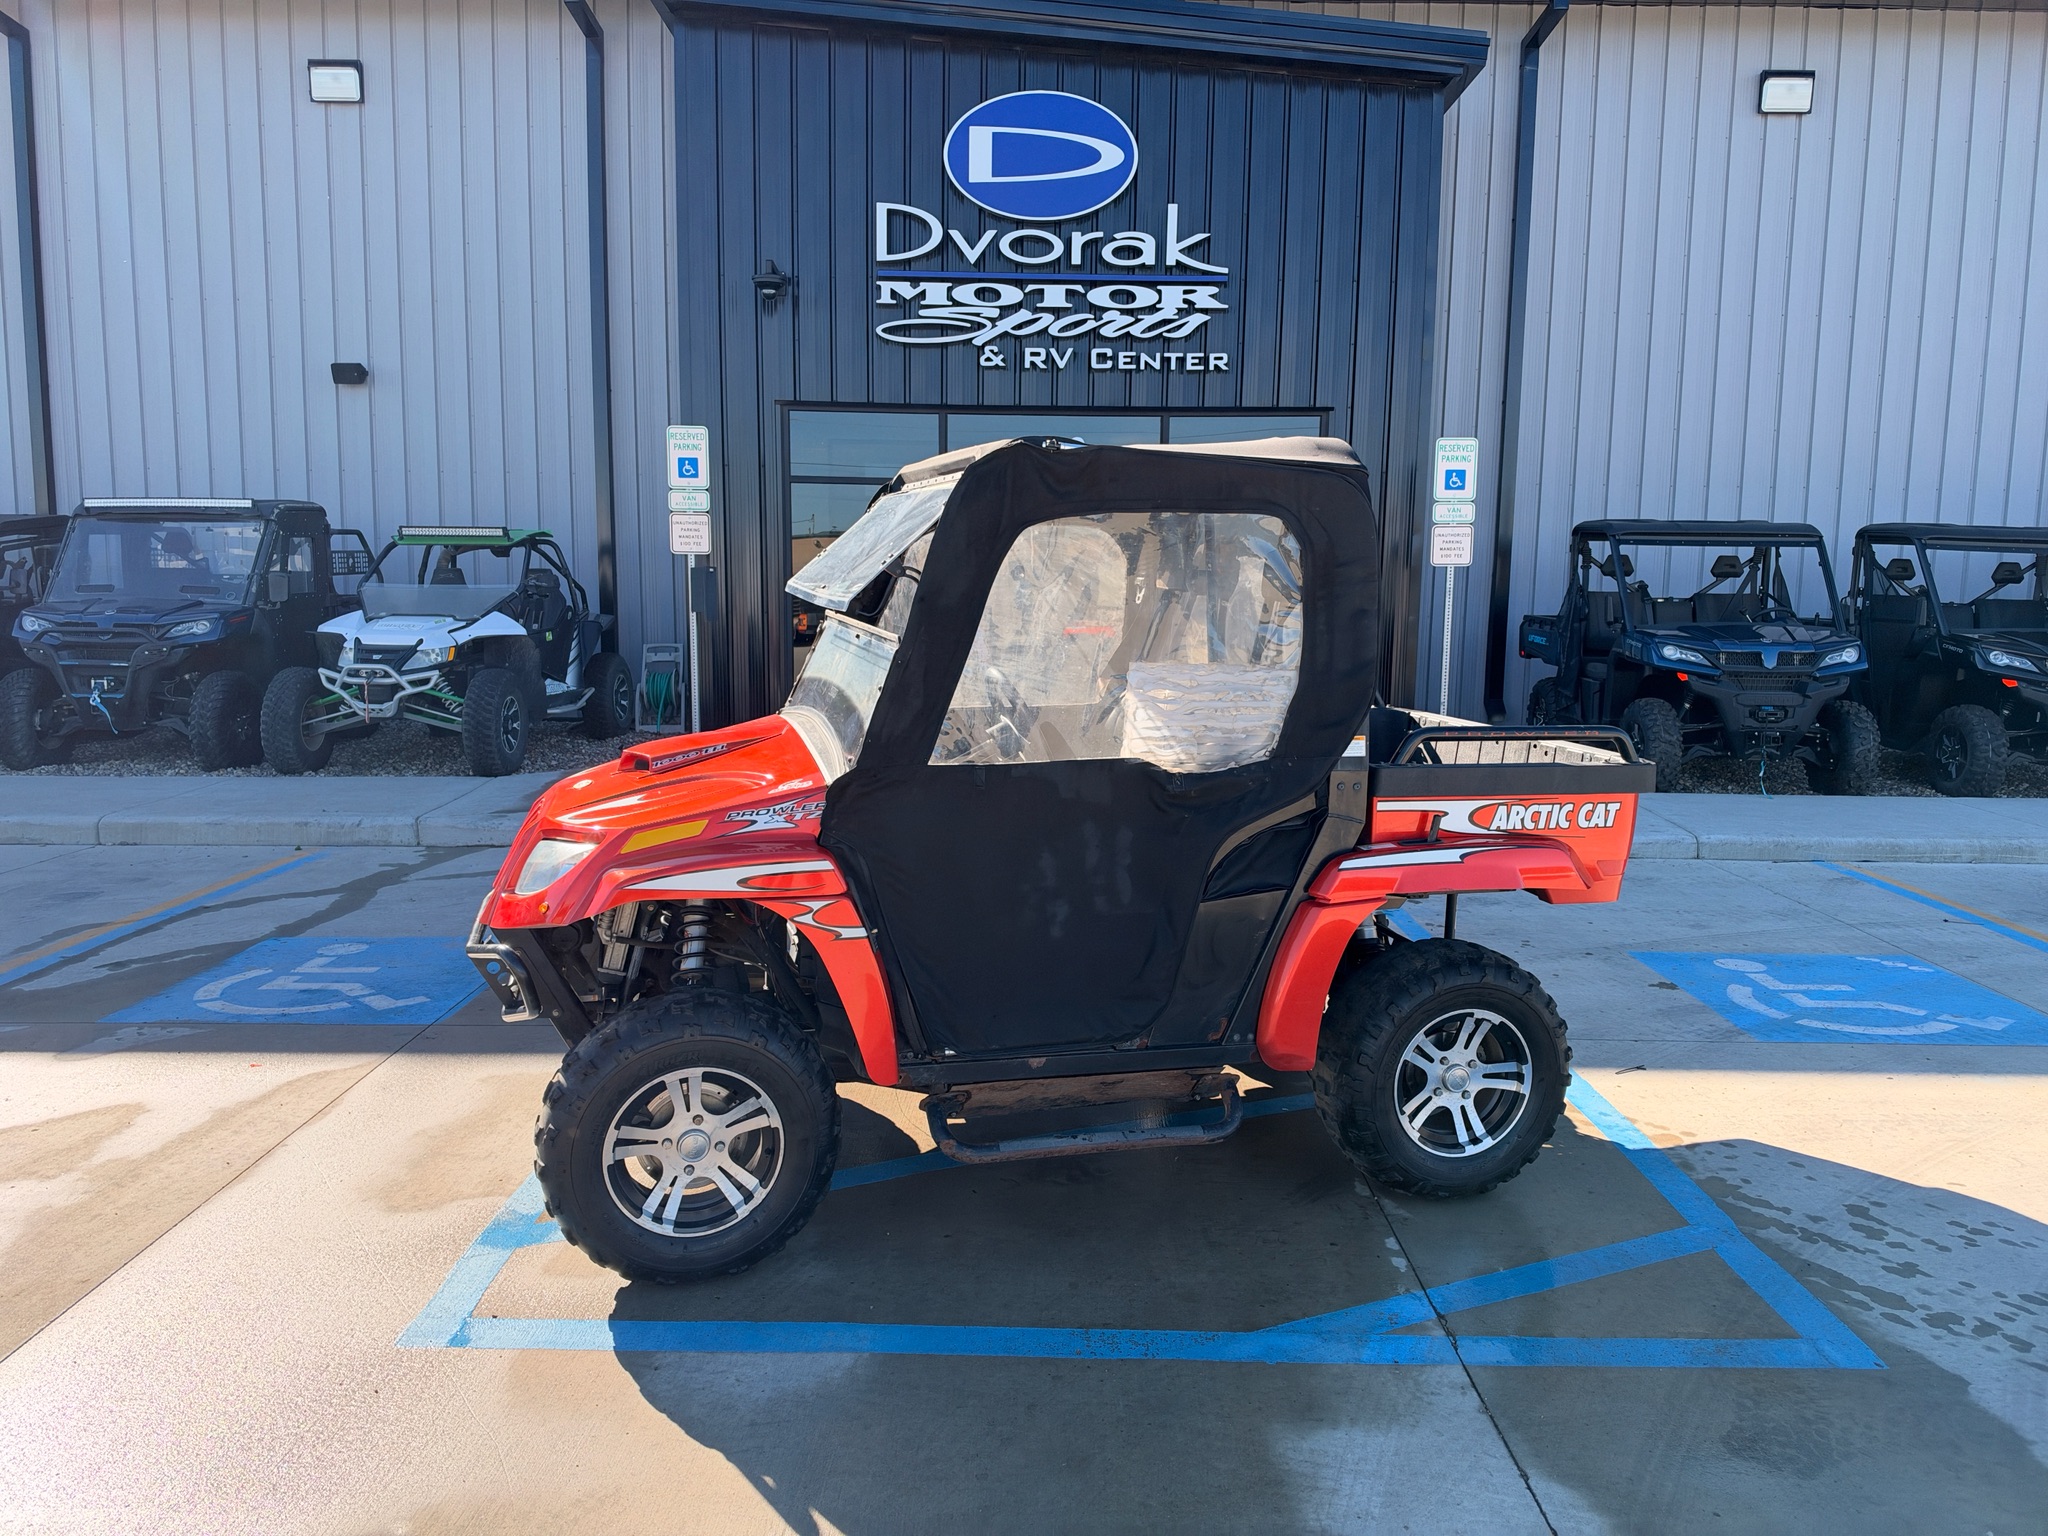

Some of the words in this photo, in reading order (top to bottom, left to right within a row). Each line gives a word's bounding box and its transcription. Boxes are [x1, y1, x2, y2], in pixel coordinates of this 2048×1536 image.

[876, 201, 1229, 274] Dvorak
[876, 280, 1229, 309] MOTOR
[875, 307, 1211, 346] Sports
[979, 345, 1006, 368] &
[1024, 347, 1074, 370] RV
[1090, 347, 1230, 371] CENTER
[670, 432, 705, 441] RESERVED
[673, 443, 702, 452] PARKING
[1439, 444, 1475, 453] RESERVED
[1441, 454, 1472, 463] PARKING
[1942, 643, 1964, 654] CFMOTO
[652, 750, 701, 769] 1000
[1487, 801, 1575, 832] ARCTIC
[1576, 800, 1623, 830] CAT
